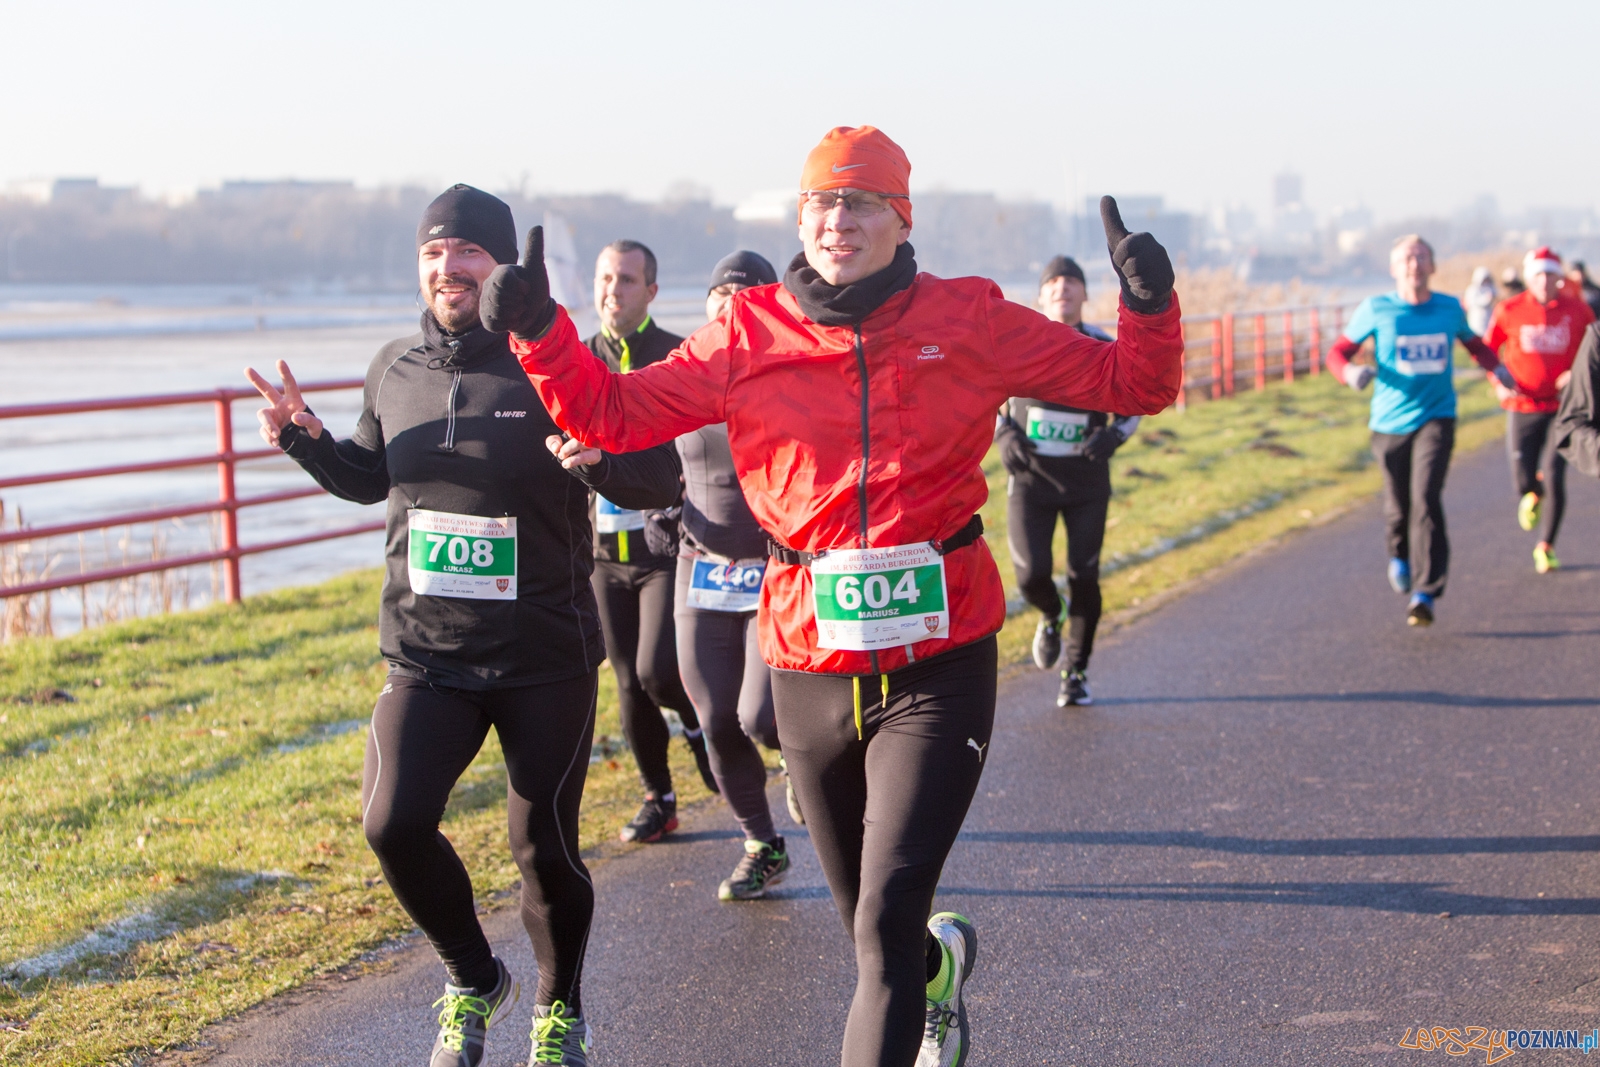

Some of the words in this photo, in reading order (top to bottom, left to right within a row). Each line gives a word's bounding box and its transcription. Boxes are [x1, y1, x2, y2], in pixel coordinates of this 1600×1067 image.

[428, 224, 445, 235] 4F
[501, 410, 527, 418] HI-TEC
[1037, 421, 1076, 441] 670
[439, 517, 456, 525] BIEG
[433, 524, 469, 534] RYSZARDA
[425, 533, 495, 568] 708
[848, 554, 868, 562] BIEG
[869, 546, 932, 561] SYLWESTROWY
[443, 565, 474, 574] ŁUKASZ
[843, 562, 887, 571] RYSZARDA
[888, 556, 930, 568] BURGIELA
[706, 564, 762, 588] 440
[835, 569, 921, 611] 604
[857, 607, 900, 619] MARIUSZ
